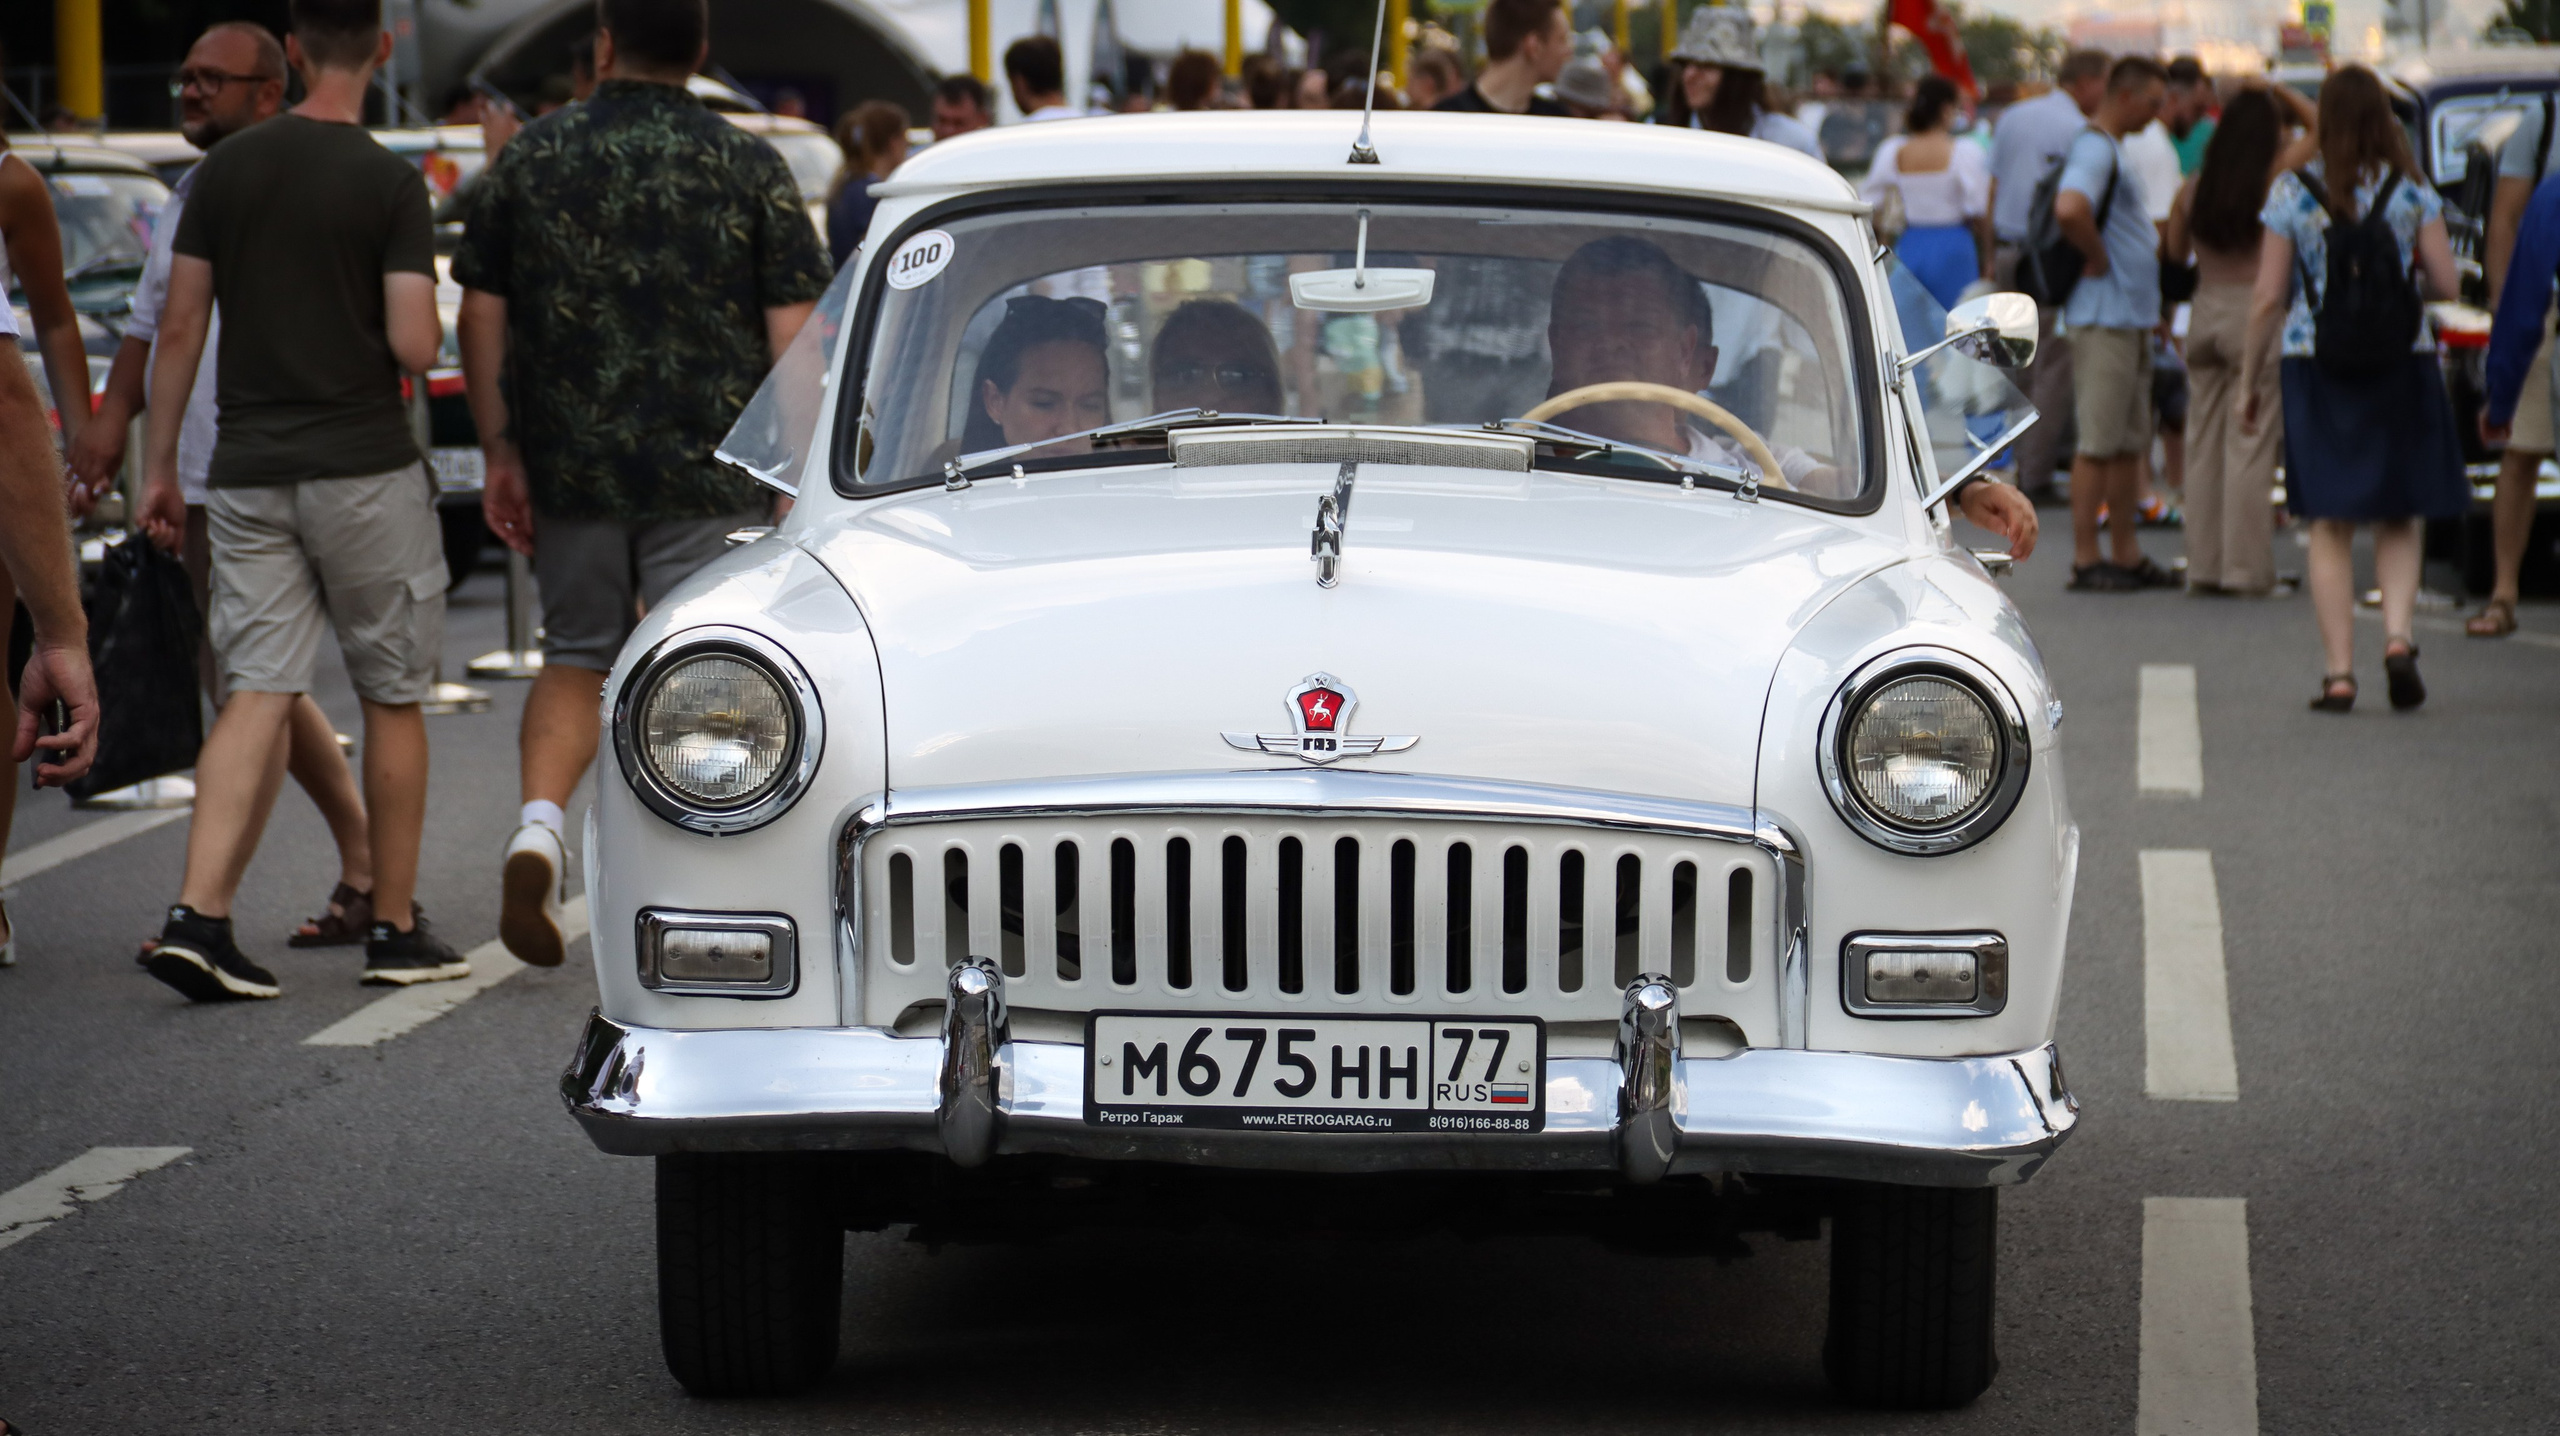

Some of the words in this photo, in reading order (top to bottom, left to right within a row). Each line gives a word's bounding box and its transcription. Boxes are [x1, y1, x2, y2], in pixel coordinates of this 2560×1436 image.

[900, 243, 941, 273] 100
[1302, 737, 1337, 751] ГАЗ
[1442, 1028, 1510, 1082] 77
[1437, 1083, 1488, 1101] RUS
[1100, 1111, 1139, 1125] Ретро
[1143, 1111, 1184, 1125] Гараж
[1242, 1113, 1392, 1128] www.RETROGARAG.ru
[1429, 1115, 1530, 1130] 8(916)166-88-88
